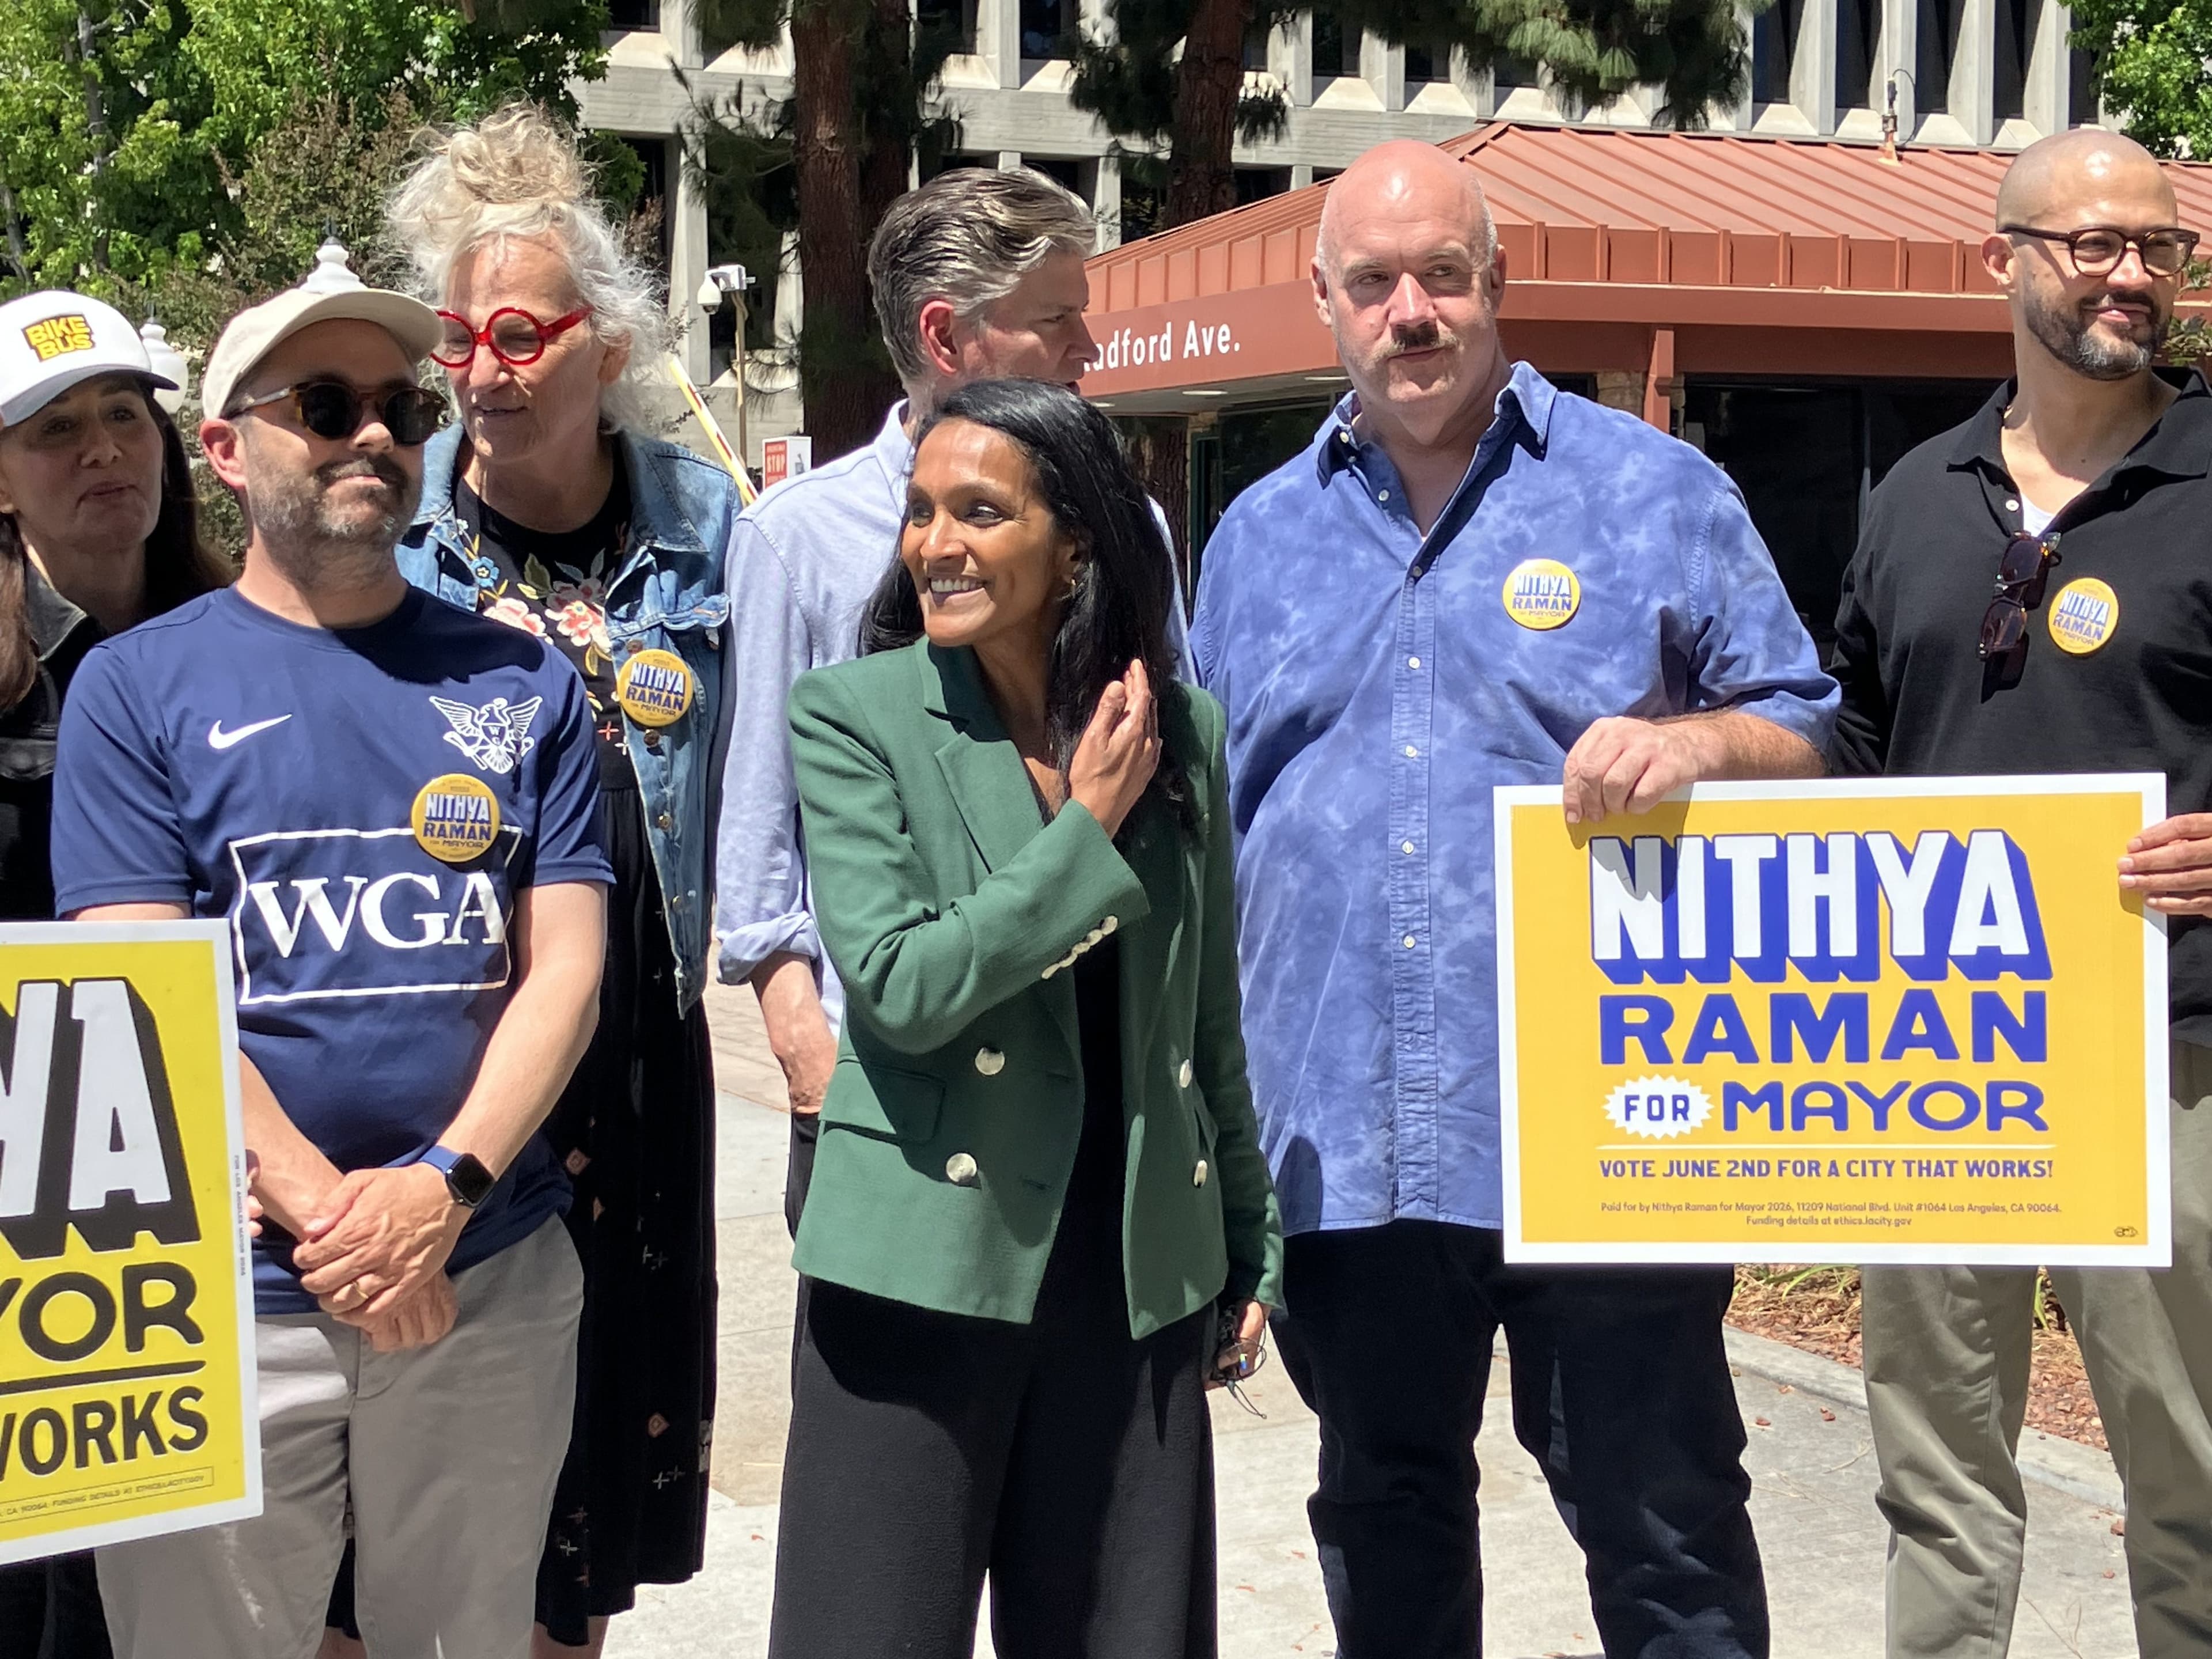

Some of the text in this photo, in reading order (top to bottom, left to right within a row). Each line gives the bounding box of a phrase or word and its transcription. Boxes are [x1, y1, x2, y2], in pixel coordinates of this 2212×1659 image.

[24, 316, 90, 346] BIKE
[35, 333, 94, 361] BUS
[1084, 320, 1241, 372] adford Ave.
[1513, 574, 1572, 598] NITHYA
[1512, 597, 1572, 611] RAMAN
[2059, 589, 2111, 627] NITHYA
[2052, 613, 2104, 641] RAMAN
[630, 662, 686, 697] NITHYA
[626, 685, 685, 711] RAMAN
[425, 793, 492, 824] NITHYA
[423, 822, 492, 840] RAMAN
[248, 869, 506, 959] WGA
[1588, 828, 2053, 985] NITHYA
[1599, 988, 2048, 1065] RAMAN
[1623, 1080, 2050, 1132] FOR MAYOR
[1599, 1160, 2054, 1178] VOTE JUNE 2ND FOR A CITY THAT WORKS!
[1601, 1202, 1622, 1212] Paid
[1623, 1202, 1638, 1212] for
[1639, 1202, 1650, 1214] by
[1652, 1202, 1684, 1214] Nithya
[1685, 1203, 1718, 1212] Raman
[1719, 1202, 1733, 1212] for
[1735, 1203, 1766, 1214] Mayor
[1826, 1202, 1867, 1213] National
[1893, 1203, 1914, 1213] Unit
[1949, 1203, 1965, 1213] Los
[2010, 1204, 2025, 1213] CA
[1746, 1215, 1785, 1228] Funding
[1786, 1216, 1819, 1226] details
[1821, 1217, 1832, 1226] at
